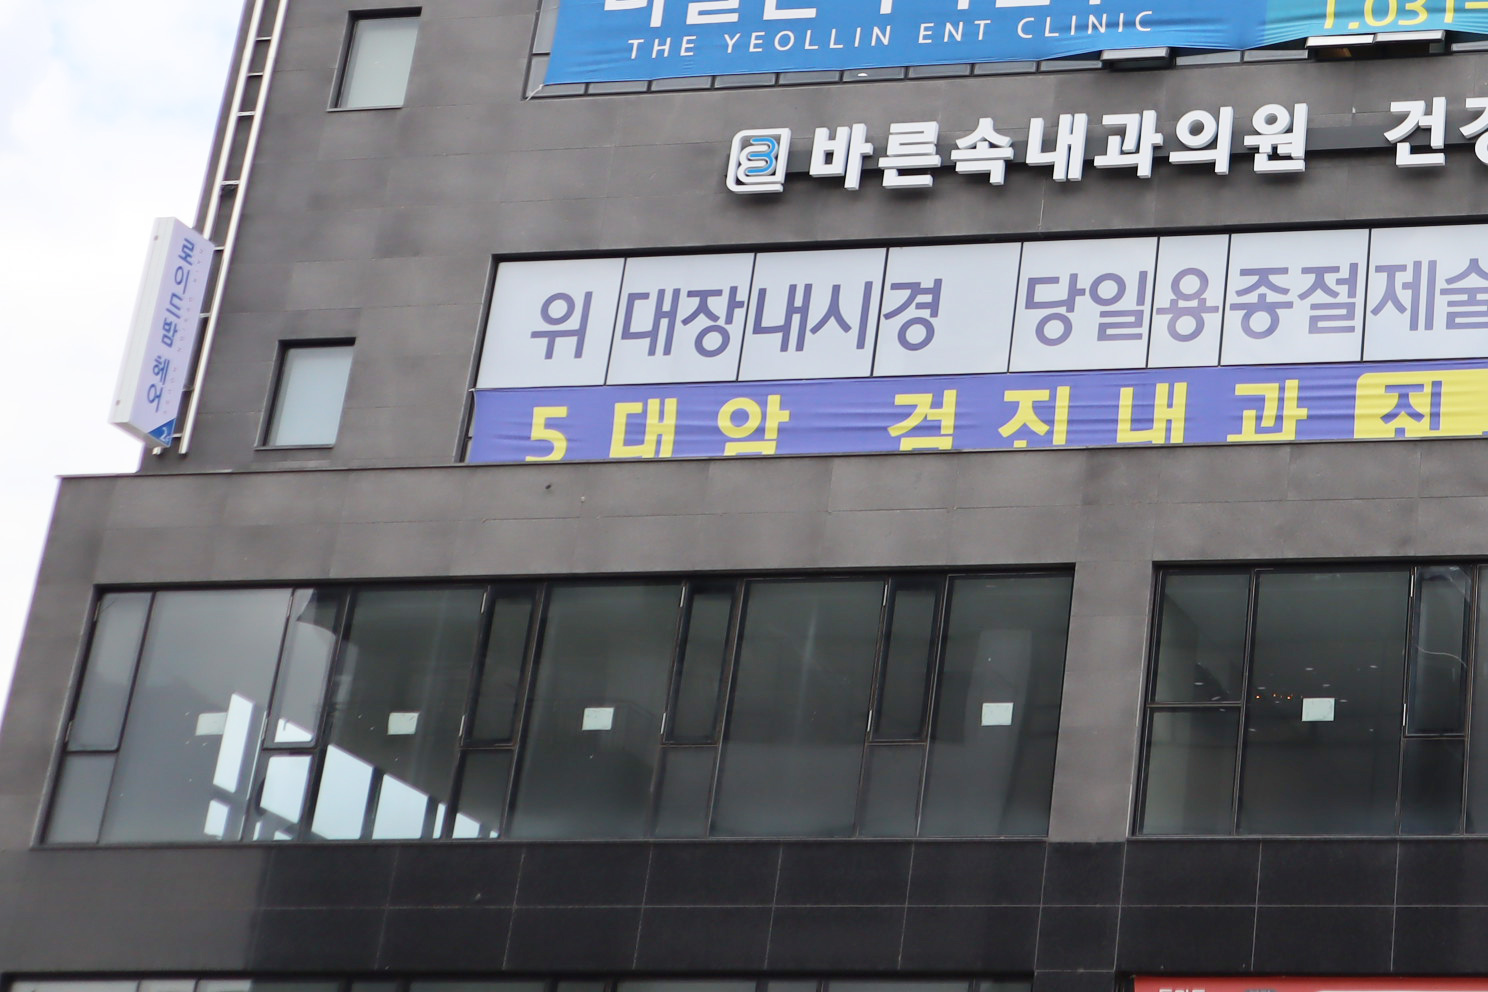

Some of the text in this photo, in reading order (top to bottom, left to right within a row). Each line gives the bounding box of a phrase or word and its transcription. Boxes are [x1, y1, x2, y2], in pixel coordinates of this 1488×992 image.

[628, 9, 1155, 61] THE YEOLLIN ENT CLINIC
[809, 102, 1308, 190] 바른속내과의원
